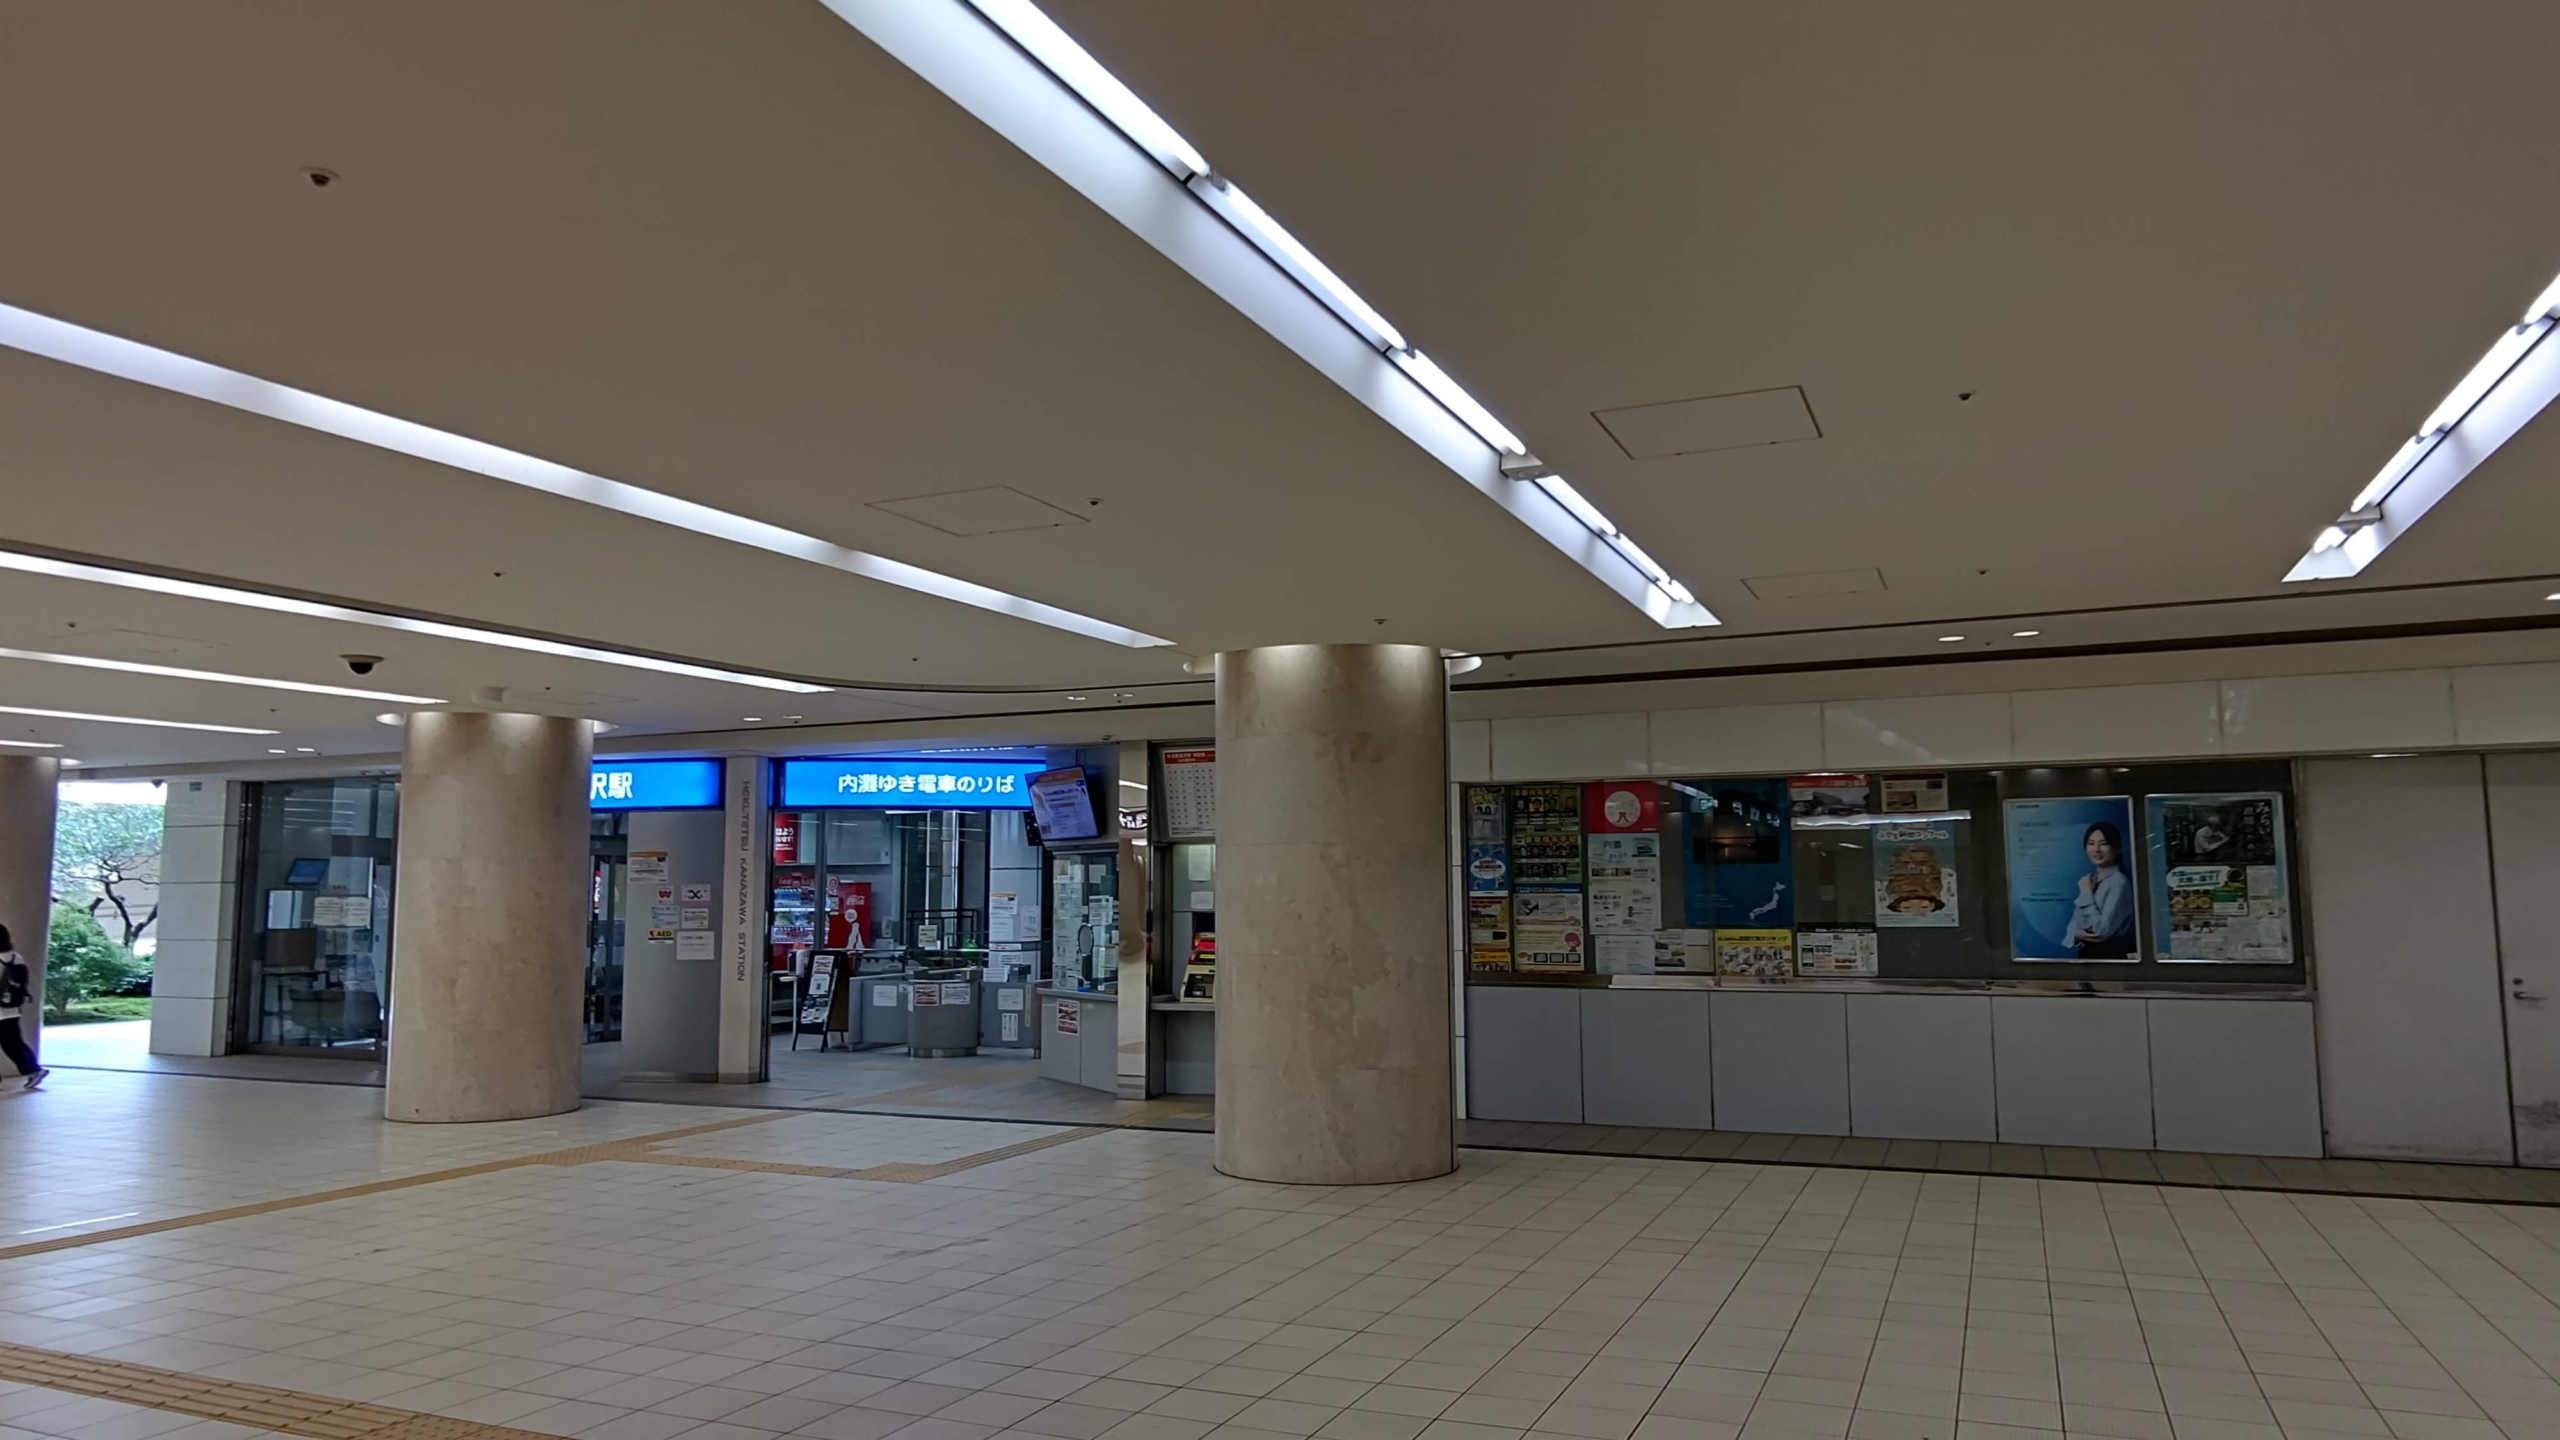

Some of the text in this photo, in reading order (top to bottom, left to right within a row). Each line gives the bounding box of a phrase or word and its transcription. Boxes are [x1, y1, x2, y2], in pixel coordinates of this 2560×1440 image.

[838, 773, 1015, 794] 内灘ゆき電車のりば
[738, 857, 749, 925] KANAZAWA
[737, 932, 747, 982] STATION
